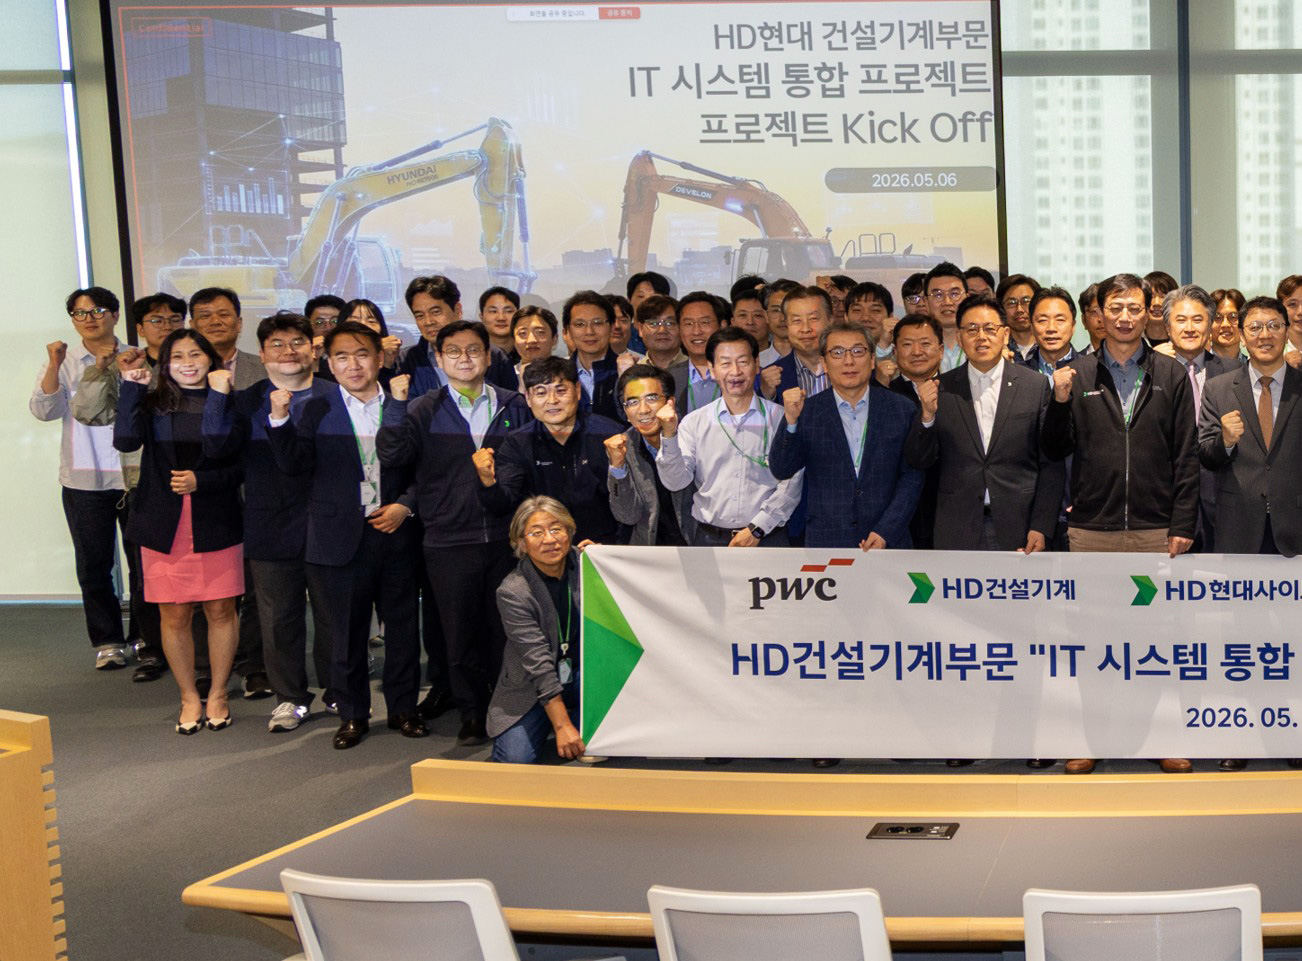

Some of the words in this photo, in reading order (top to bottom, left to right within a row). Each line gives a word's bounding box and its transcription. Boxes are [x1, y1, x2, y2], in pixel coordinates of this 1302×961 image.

[714, 21, 813, 51] HD현대
[822, 19, 989, 51] 건설기계부문
[629, 67, 660, 97] IT
[672, 63, 770, 99] 시스템
[782, 62, 848, 98] 통합
[859, 60, 991, 97] 프로젝트
[700, 111, 832, 147] 프로젝트
[842, 111, 920, 143] Kick
[930, 111, 993, 143] Off
[387, 165, 437, 185] HYUNDAI
[872, 173, 957, 187] 2026.05.06
[675, 186, 712, 198] DEVELON
[748, 572, 837, 609] pwc
[943, 578, 1075, 600] HD건설기계
[732, 641, 1017, 681] HD건설기계부문
[1098, 643, 1207, 680] 시스템
[1221, 643, 1295, 681] 통합
